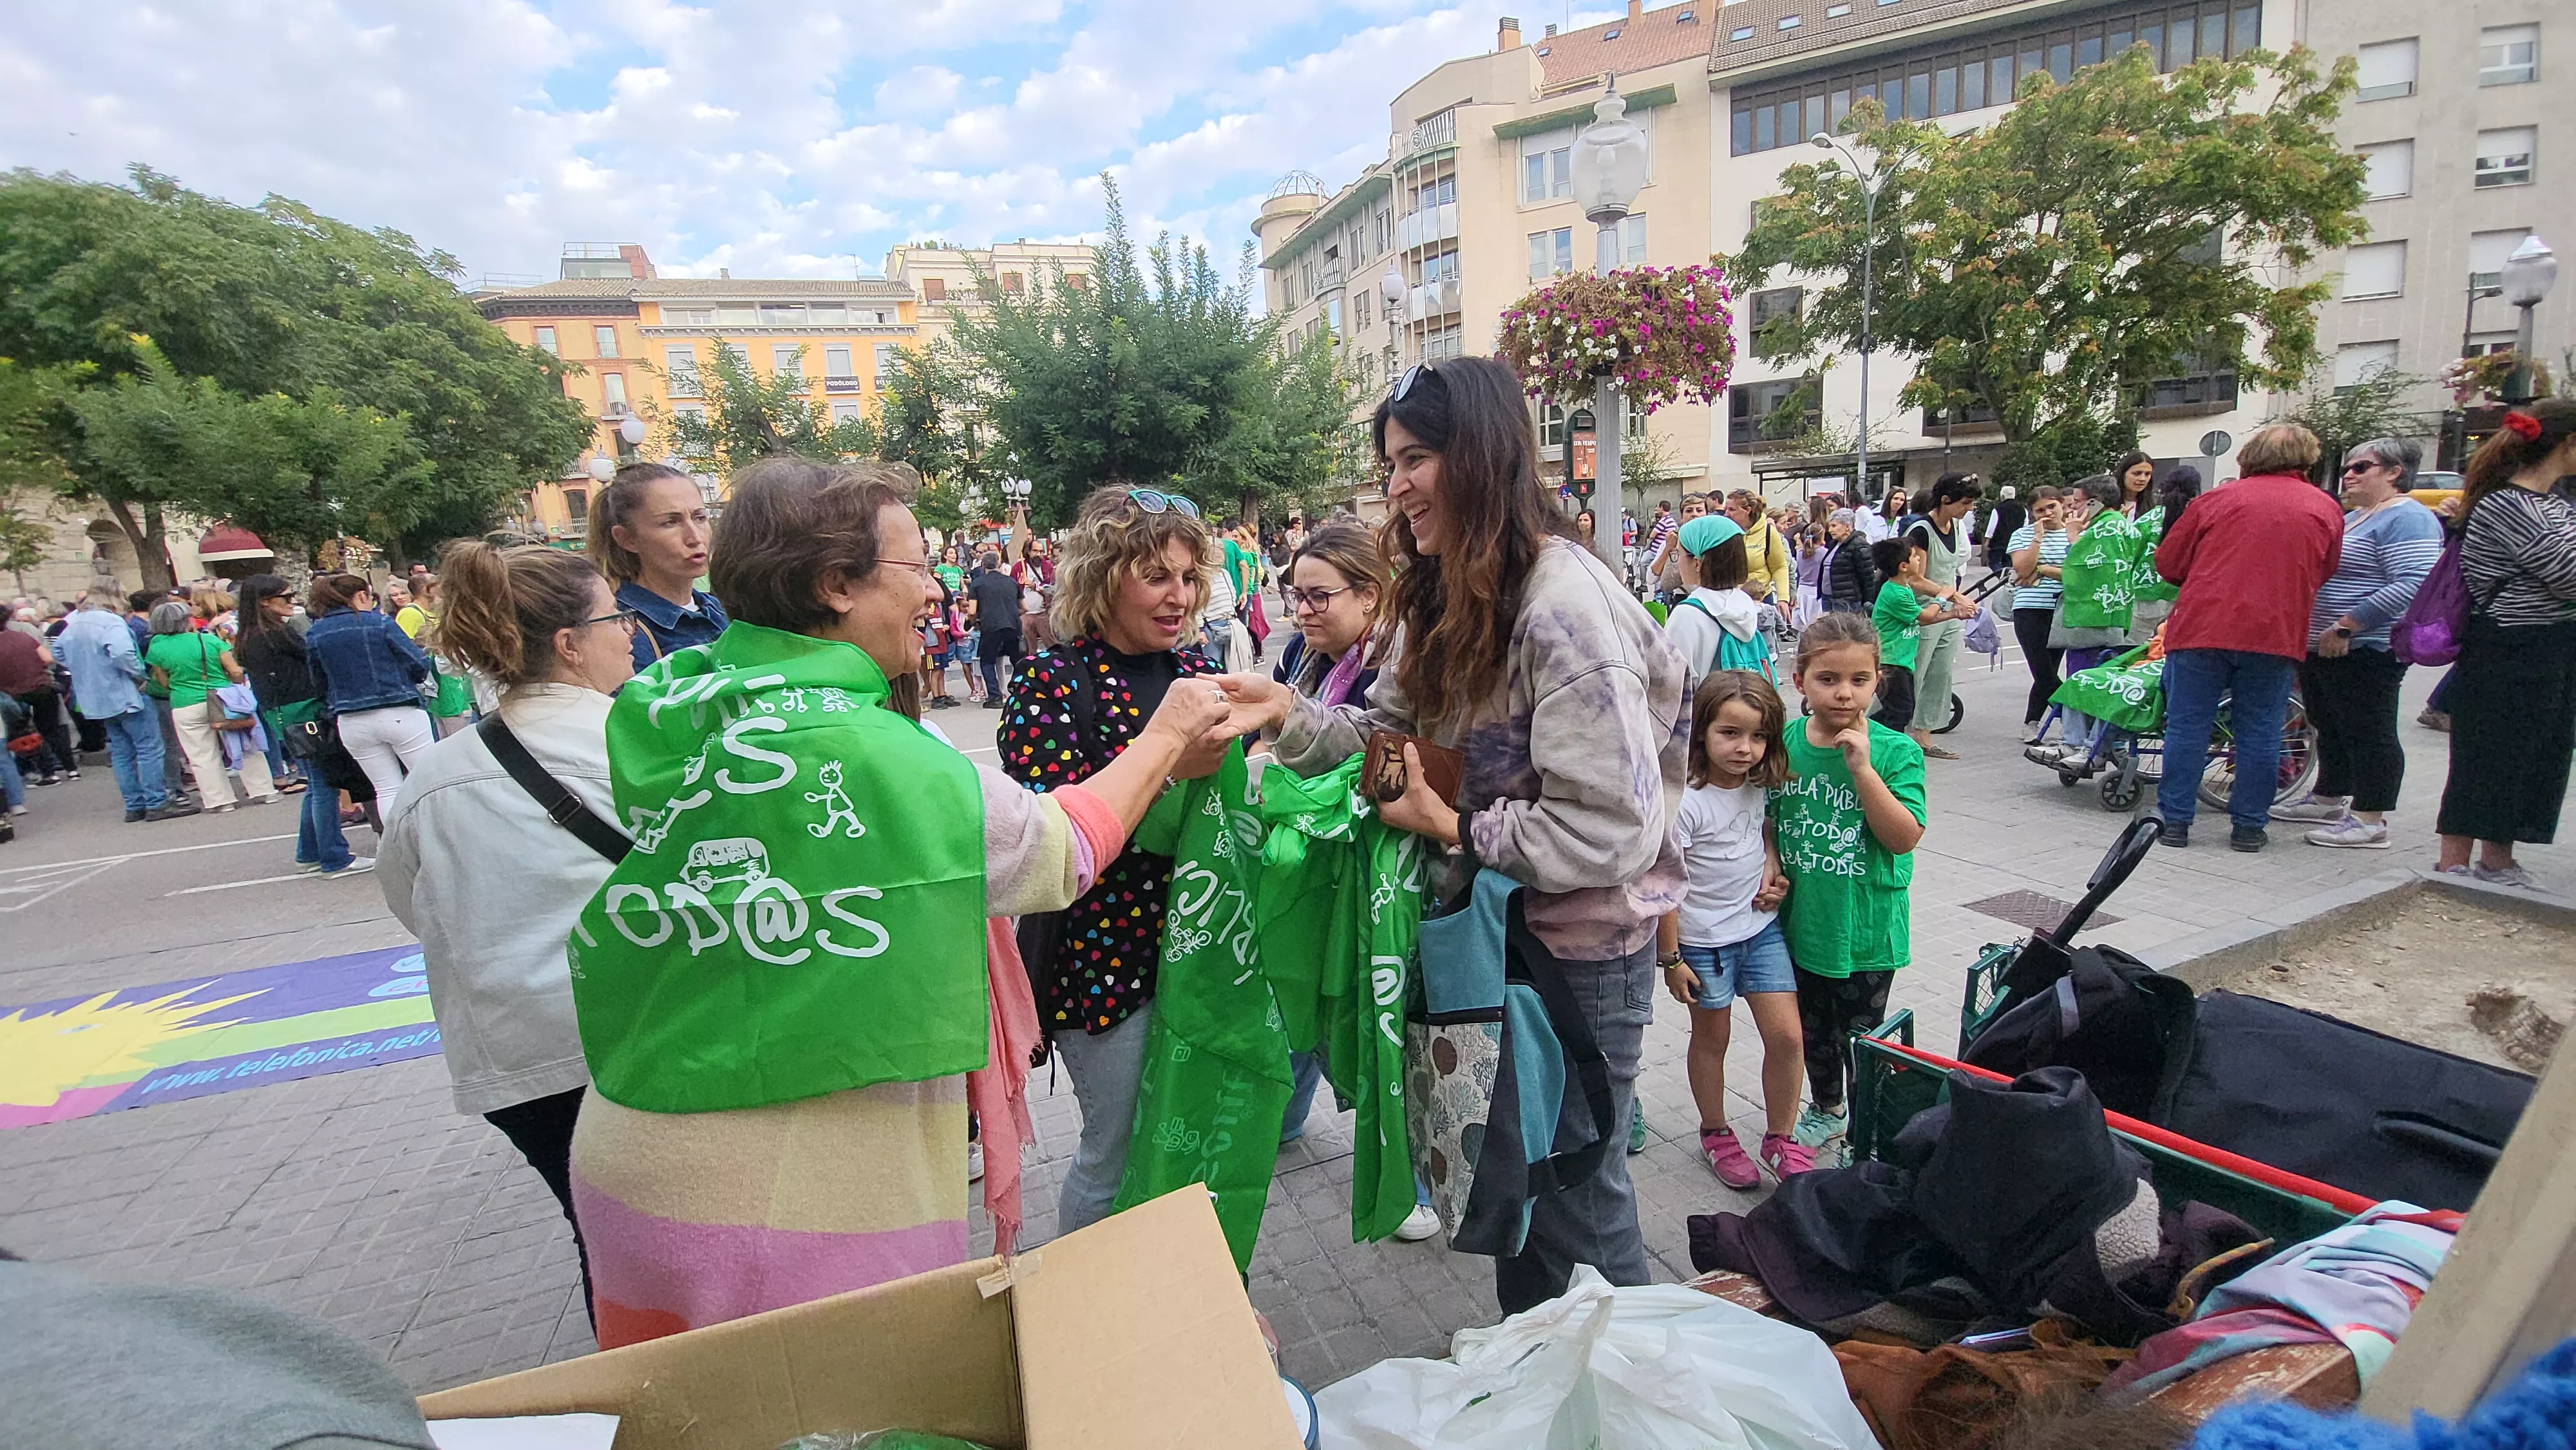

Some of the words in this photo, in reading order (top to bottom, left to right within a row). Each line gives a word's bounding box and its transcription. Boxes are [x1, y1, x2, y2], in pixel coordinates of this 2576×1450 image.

[1824, 782, 1864, 811] PÚBL
[1799, 820, 1857, 847] TOD@
[1808, 852, 1866, 879] TODS
[141, 1027, 441, 1094] www.telefonica.net/
